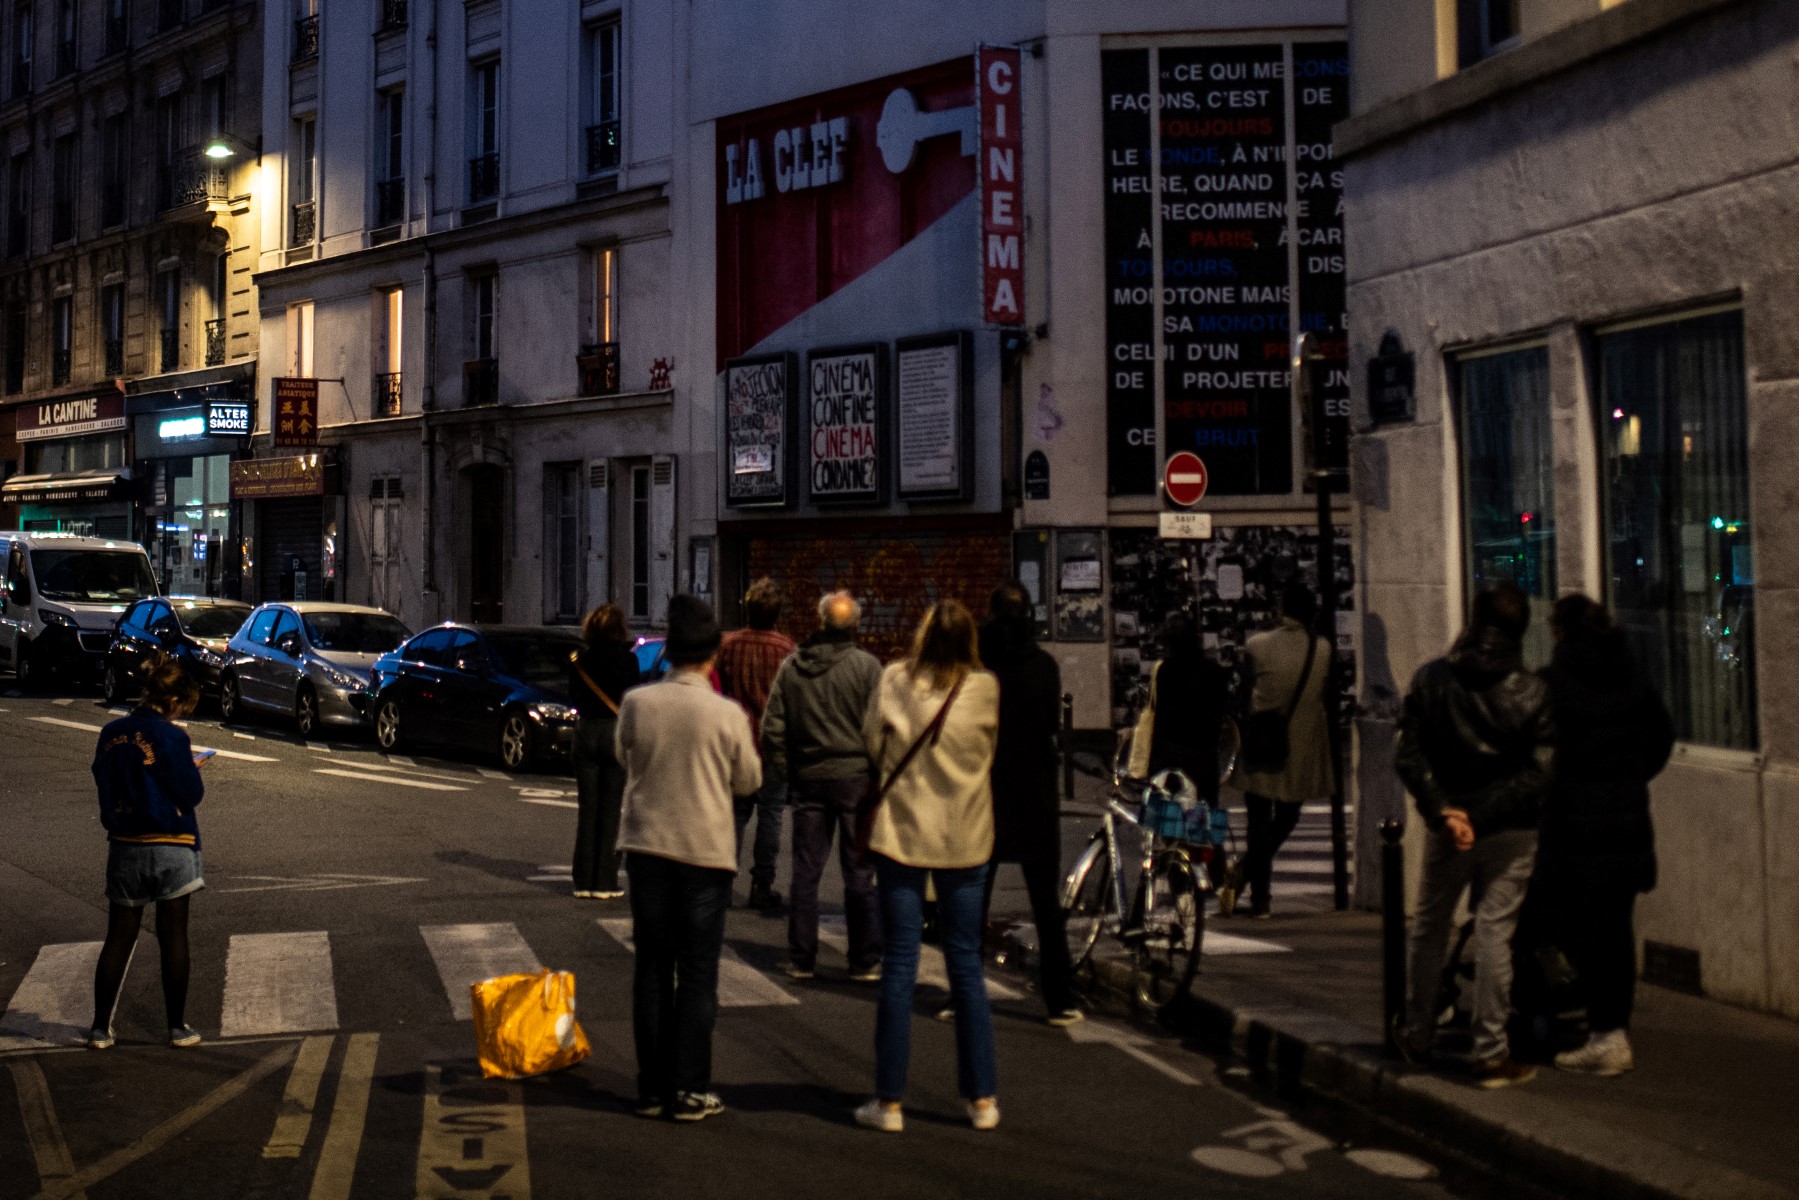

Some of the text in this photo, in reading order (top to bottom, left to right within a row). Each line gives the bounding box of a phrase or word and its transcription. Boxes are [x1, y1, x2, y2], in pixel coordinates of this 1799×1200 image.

[1174, 64, 1203, 81] CE
[1210, 63, 1247, 80] QUI
[1303, 87, 1332, 105] DE
[725, 116, 851, 205] LA CLEF
[1112, 149, 1138, 166] LE
[1232, 142, 1247, 163] À
[988, 61, 1019, 314] CINEMA
[1194, 173, 1273, 193] QUAND
[1165, 314, 1193, 332] SA
[1187, 342, 1239, 361] D'UN
[1115, 371, 1144, 389] DE
[39, 397, 98, 425] LA CANTINE
[209, 408, 248, 419] ALTER
[209, 418, 248, 429] SMOKE
[1194, 427, 1261, 446] BRUIT
